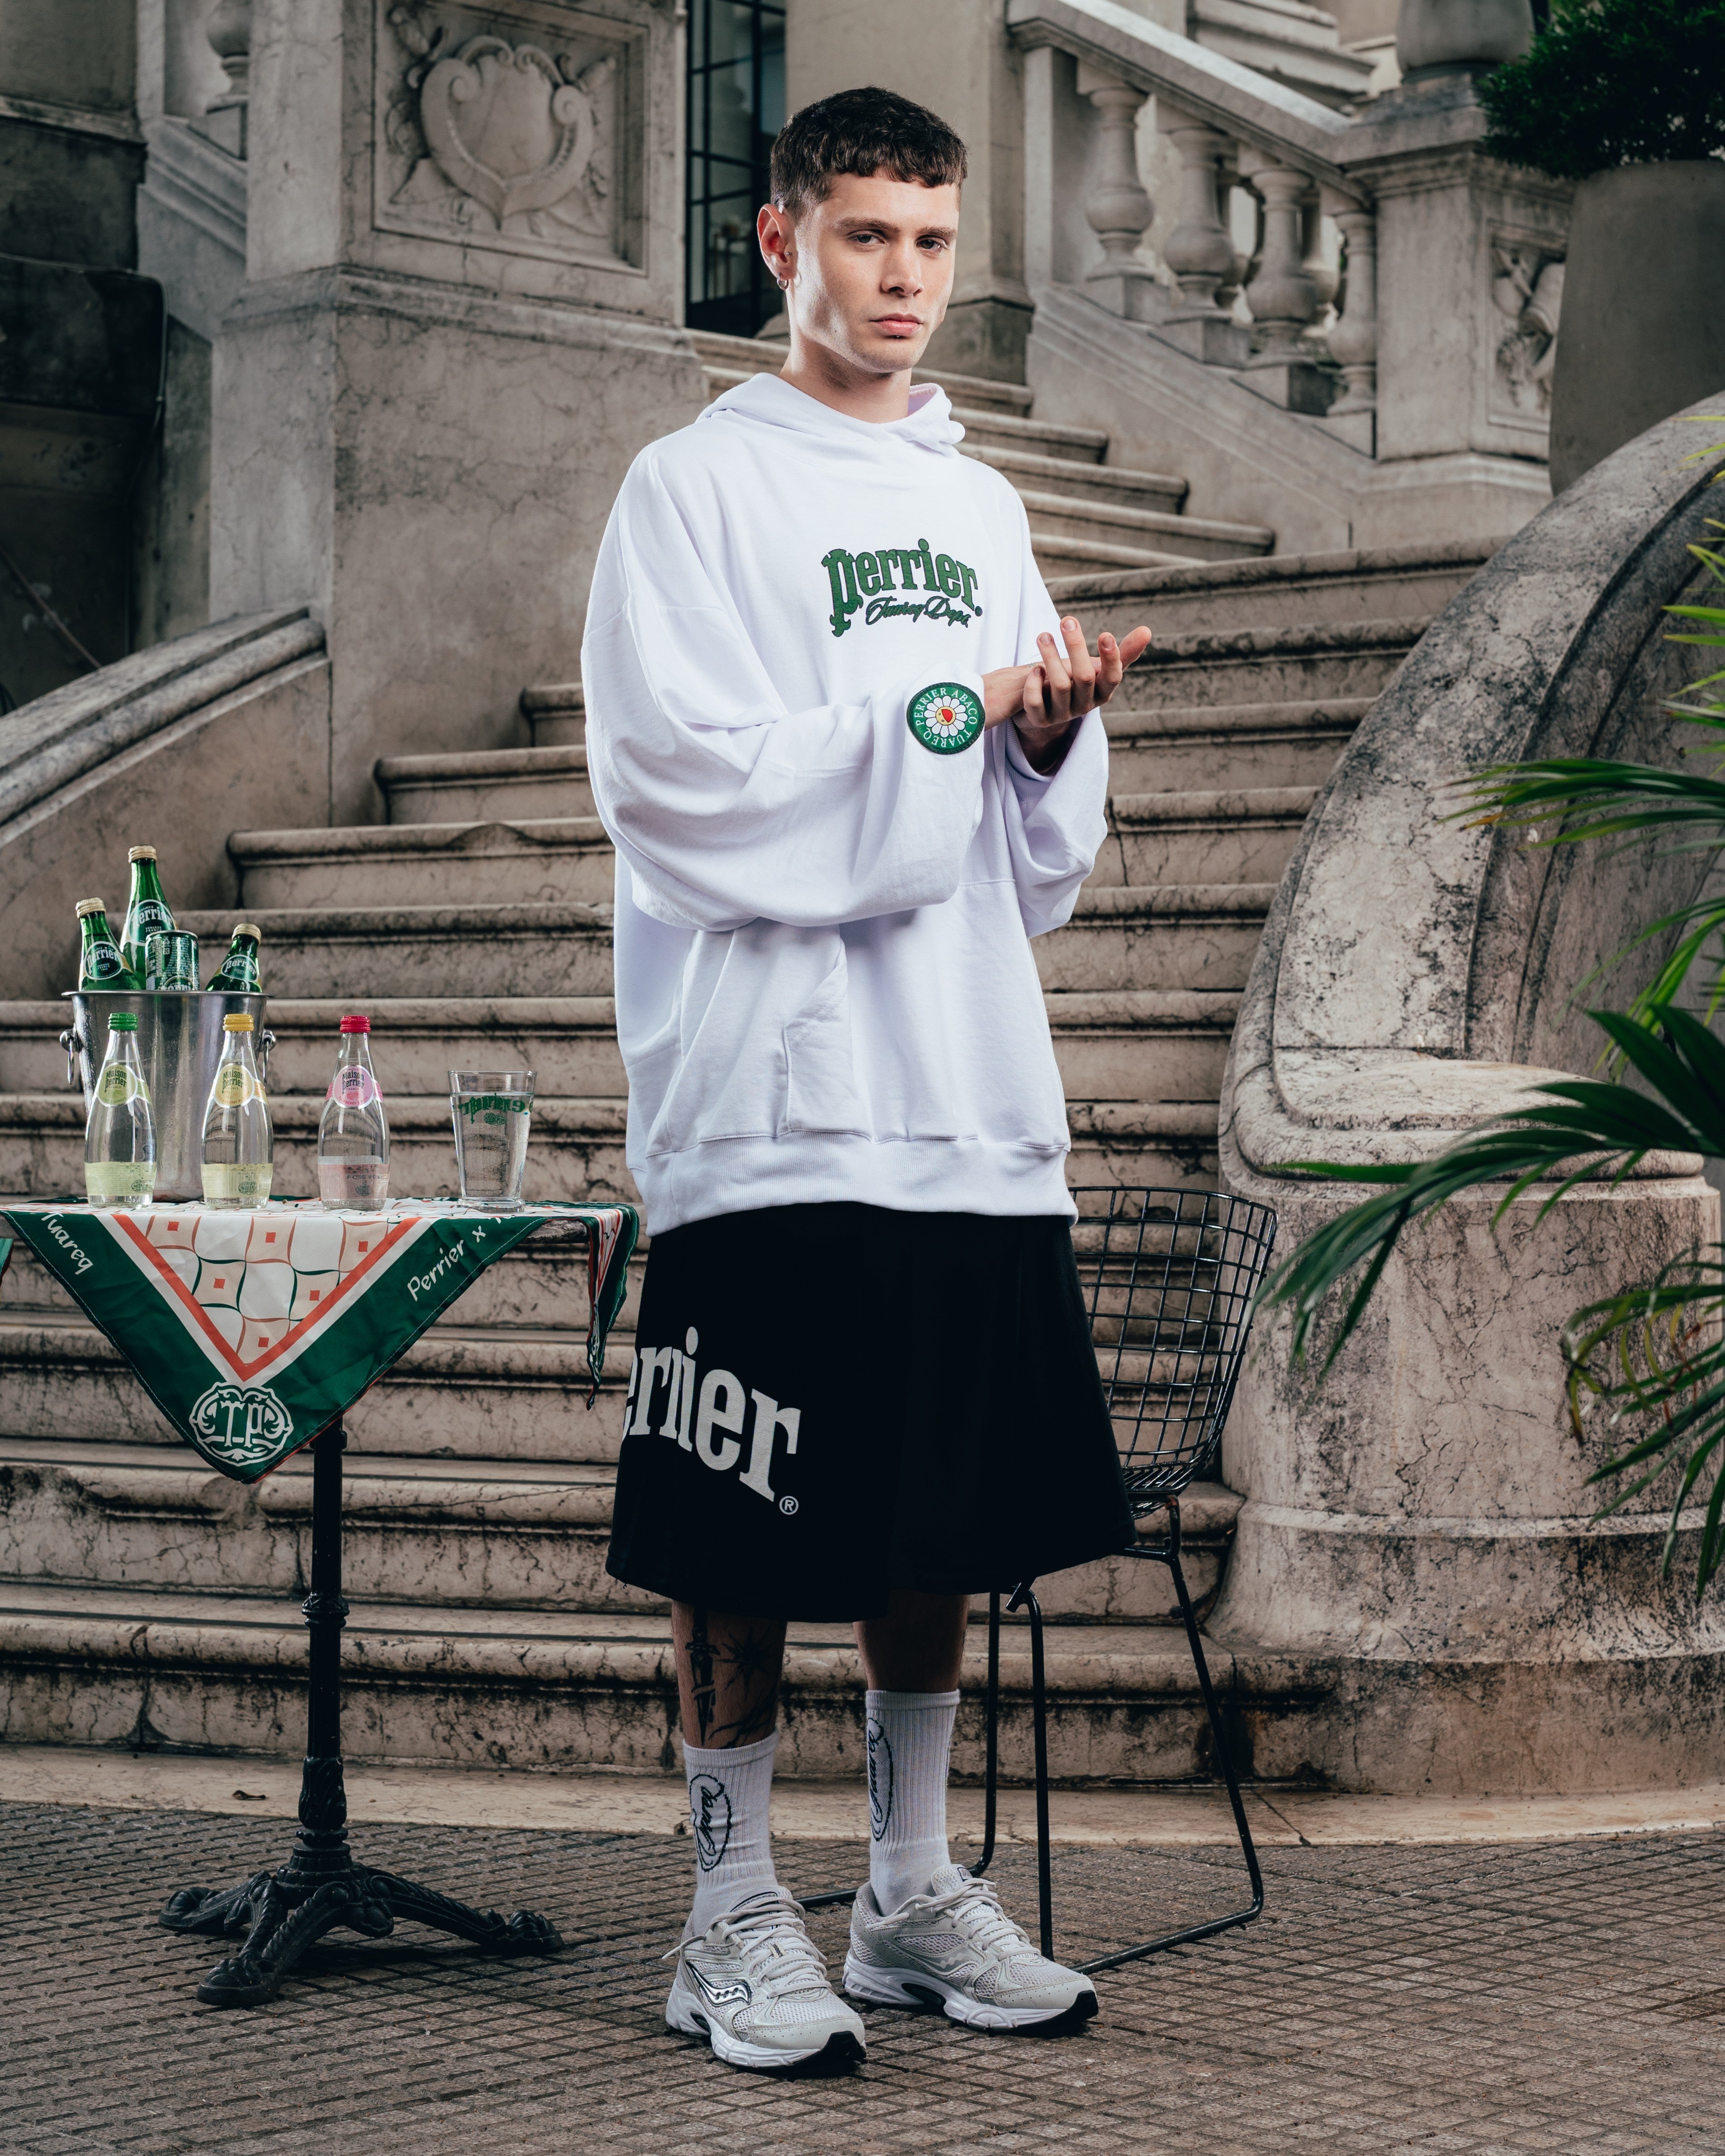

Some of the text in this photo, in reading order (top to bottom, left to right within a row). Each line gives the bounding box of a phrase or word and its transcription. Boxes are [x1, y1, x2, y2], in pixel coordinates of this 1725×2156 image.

[914, 687, 978, 748] PERRIER ABACO TUAREQ
[87, 946, 119, 975] perrier
[106, 1068, 127, 1080] Maison
[223, 1069, 244, 1080] Maison
[342, 1070, 364, 1081] Maison
[407, 1239, 464, 1302] Perrier
